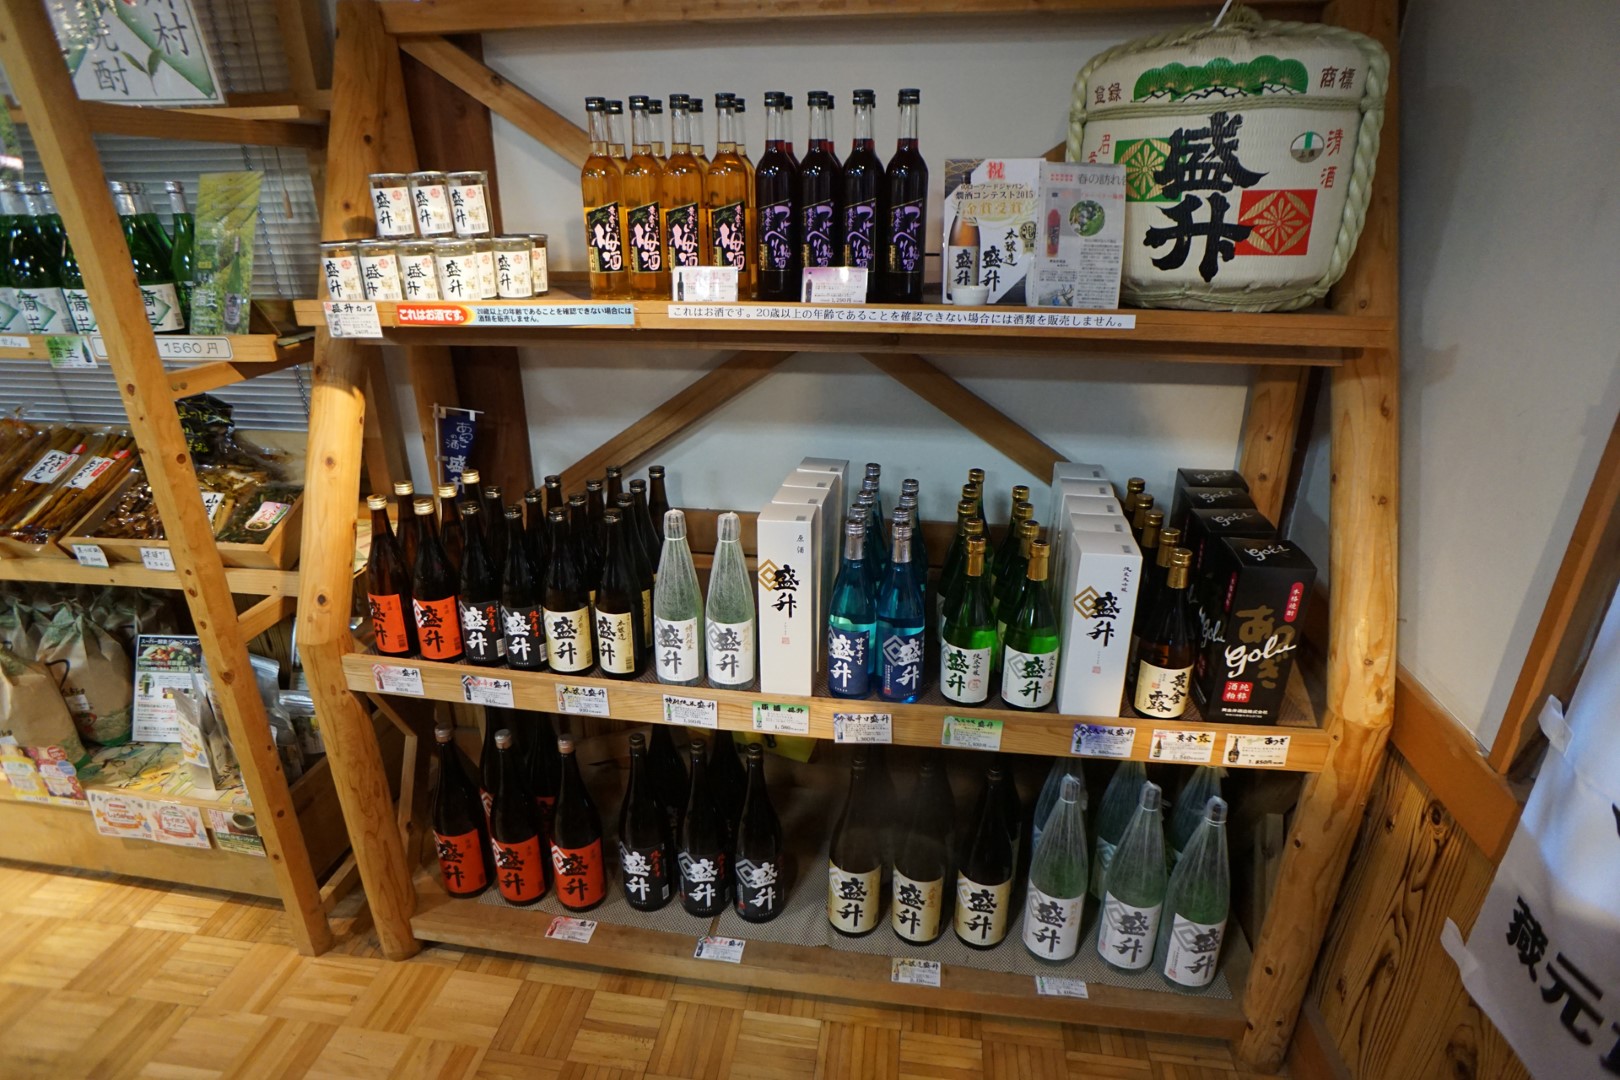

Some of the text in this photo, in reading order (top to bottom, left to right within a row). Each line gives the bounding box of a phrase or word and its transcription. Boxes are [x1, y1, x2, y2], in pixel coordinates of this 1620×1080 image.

[145, 0, 189, 56] 村
[1094, 83, 1122, 105] 登録
[1320, 67, 1355, 90] 商標
[987, 161, 1006, 180] 祝
[1320, 128, 1344, 189] 清酒
[376, 191, 393, 229] 盛升
[417, 189, 432, 228] 盛升
[452, 189, 467, 228] 盛升
[967, 201, 1025, 214] 金賞受賞
[1143, 111, 1269, 283] 盛升
[326, 260, 341, 298] 盛升
[366, 263, 383, 296] 盛升
[407, 263, 427, 296] 盛升
[446, 260, 462, 297] 盛升
[498, 255, 511, 291] 盛升
[954, 249, 973, 286] 盛升
[980, 246, 1002, 292] 盛升
[399, 308, 465, 321] これはお酒です。
[477, 307, 632, 316] 20歳以上の年齢であることを確認できない場合には
[478, 315, 540, 323] 酒類を販売しません。
[796, 534, 805, 554] 原酒
[771, 564, 800, 618] 盛升
[1286, 589, 1300, 617] 本格焼酎
[369, 598, 388, 647] 盛升
[422, 605, 445, 653] 盛升
[464, 606, 488, 656] 盛升
[507, 611, 531, 662] 盛升
[553, 616, 577, 666] 盛升
[598, 616, 616, 666] 盛升
[1087, 592, 1122, 647] 盛升
[658, 624, 684, 674] 盛升
[715, 628, 742, 678] 盛升
[829, 634, 855, 688] 盛升
[896, 638, 922, 691] 盛升
[946, 650, 969, 697] 盛升
[1018, 656, 1046, 703] 盛升
[1146, 691, 1172, 712] 露
[439, 839, 464, 888] 盛升
[500, 847, 524, 896] 盛升
[562, 853, 588, 902] 盛升
[624, 851, 652, 901] 盛升
[689, 858, 718, 908] 盛升
[749, 861, 778, 911] 盛升
[836, 877, 867, 928] 盛升
[896, 883, 925, 935] 盛升
[963, 889, 997, 940] 盛升
[1032, 901, 1068, 953] 盛升
[1112, 911, 1150, 963] 盛升
[1184, 928, 1221, 979] 盛升
